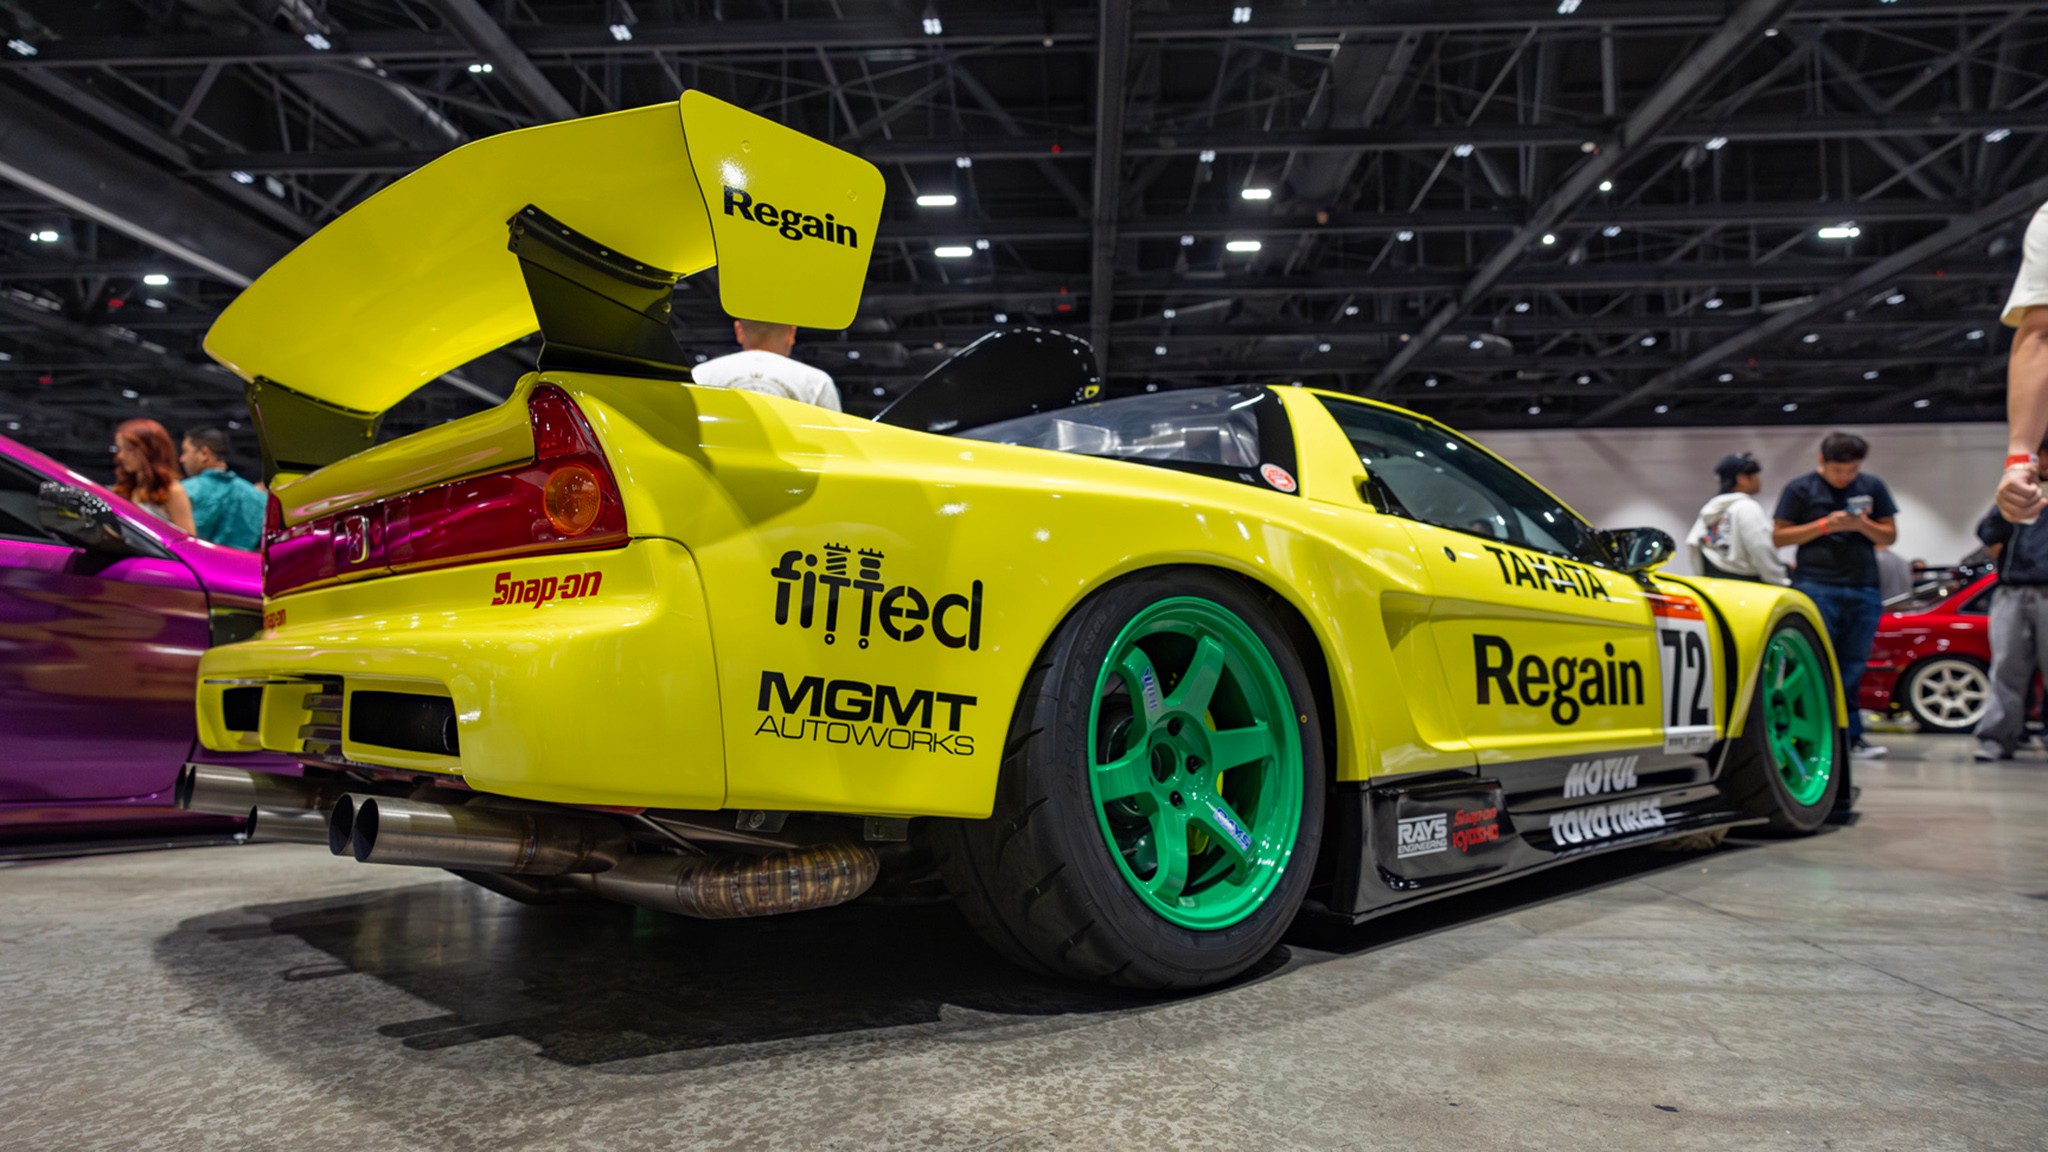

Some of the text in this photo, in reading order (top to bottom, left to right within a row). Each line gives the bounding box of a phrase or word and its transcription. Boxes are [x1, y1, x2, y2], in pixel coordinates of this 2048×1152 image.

[722, 185, 858, 248] Regain
[491, 571, 602, 609] Snap-on
[1482, 544, 1610, 602] TAKATA
[771, 543, 983, 651] fitted
[1472, 633, 1645, 727] Regain
[1660, 629, 1710, 726] 72
[757, 670, 978, 732] MGMT
[755, 714, 975, 756] AUTOWORKS
[1563, 755, 1640, 799] MOTUL
[1398, 818, 1447, 845] RAYS
[1453, 806, 1498, 827] Snap-on
[1453, 823, 1499, 853] KYOSHO
[1398, 837, 1448, 854] ENGINEERING
